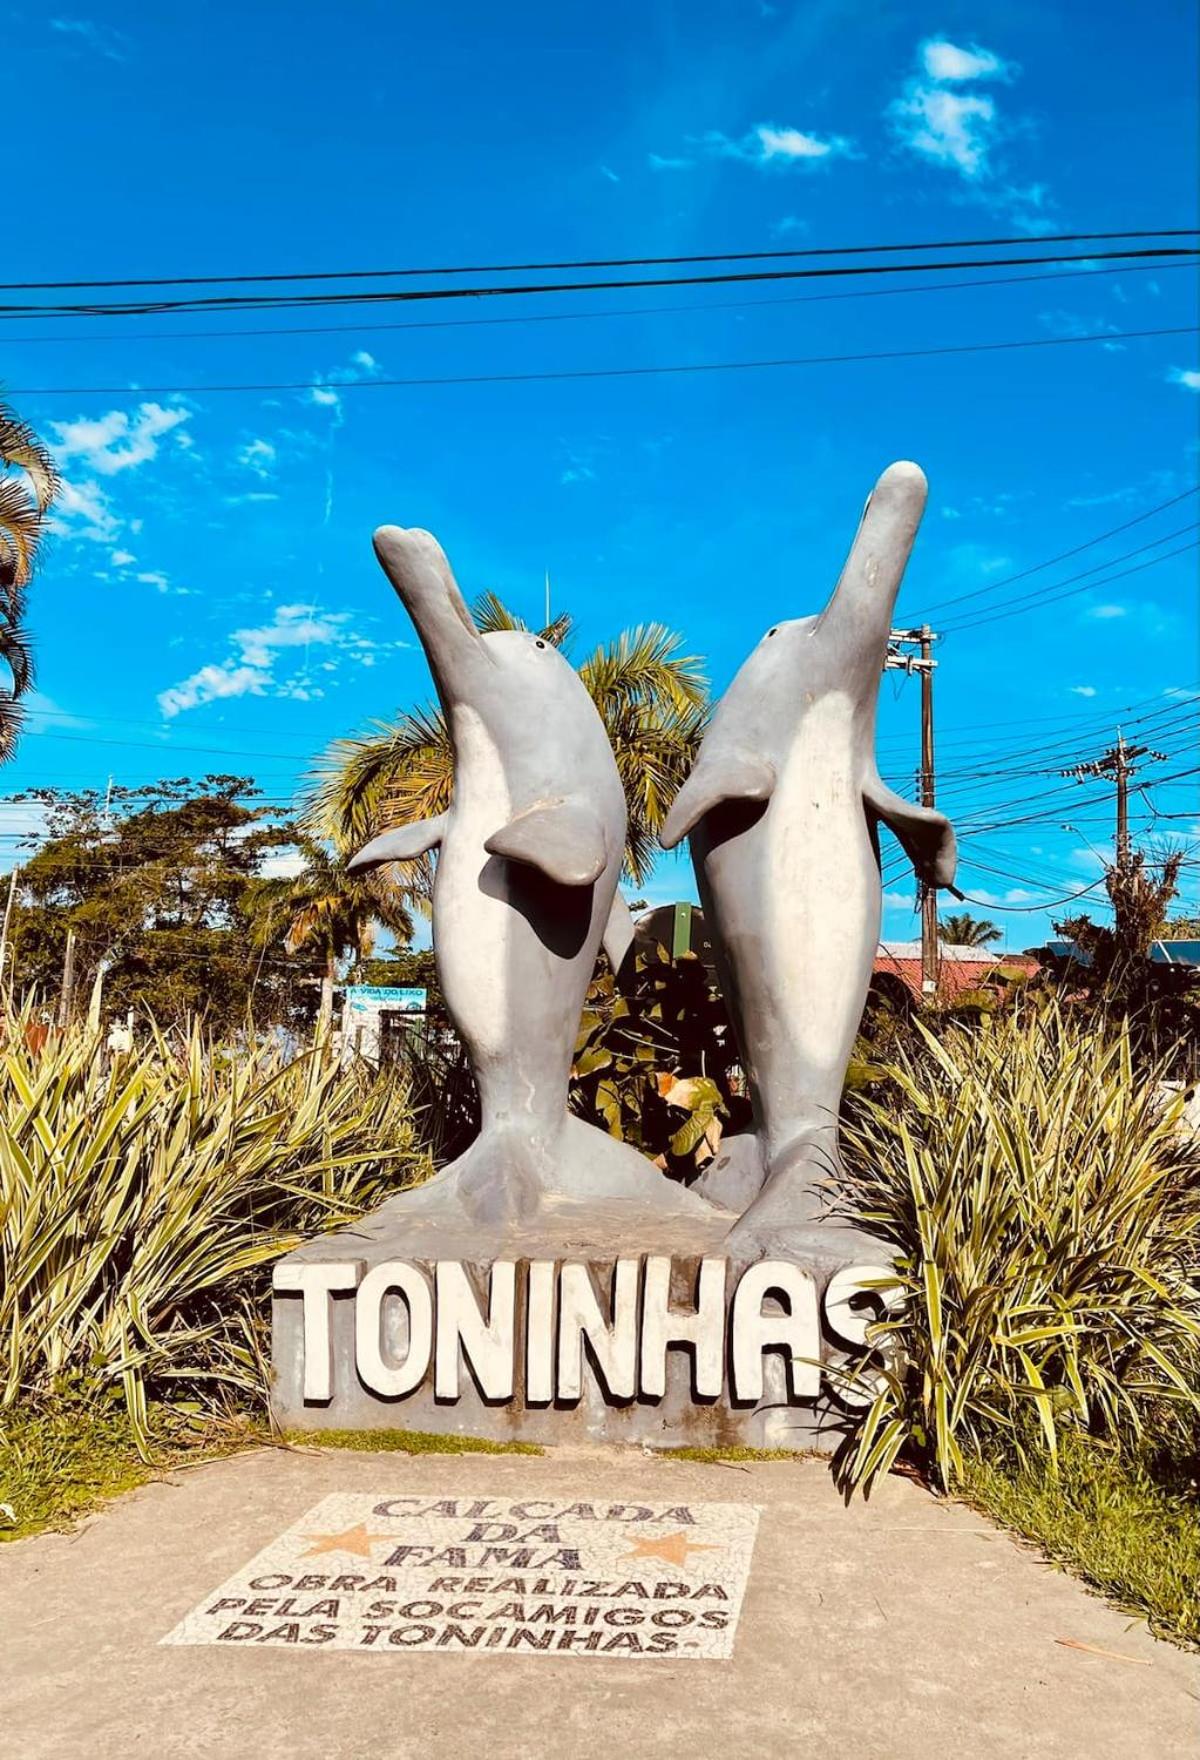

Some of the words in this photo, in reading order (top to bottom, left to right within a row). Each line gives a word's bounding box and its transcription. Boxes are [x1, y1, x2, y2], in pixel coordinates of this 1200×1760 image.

[272, 1254, 907, 1408] TONINHAS
[460, 1522, 561, 1544] DA
[380, 1545, 585, 1571] FAMA
[248, 1574, 398, 1594] OBRA
[429, 1576, 730, 1601] REALIZADA
[205, 1597, 340, 1618] PELA
[216, 1621, 338, 1644] DAS
